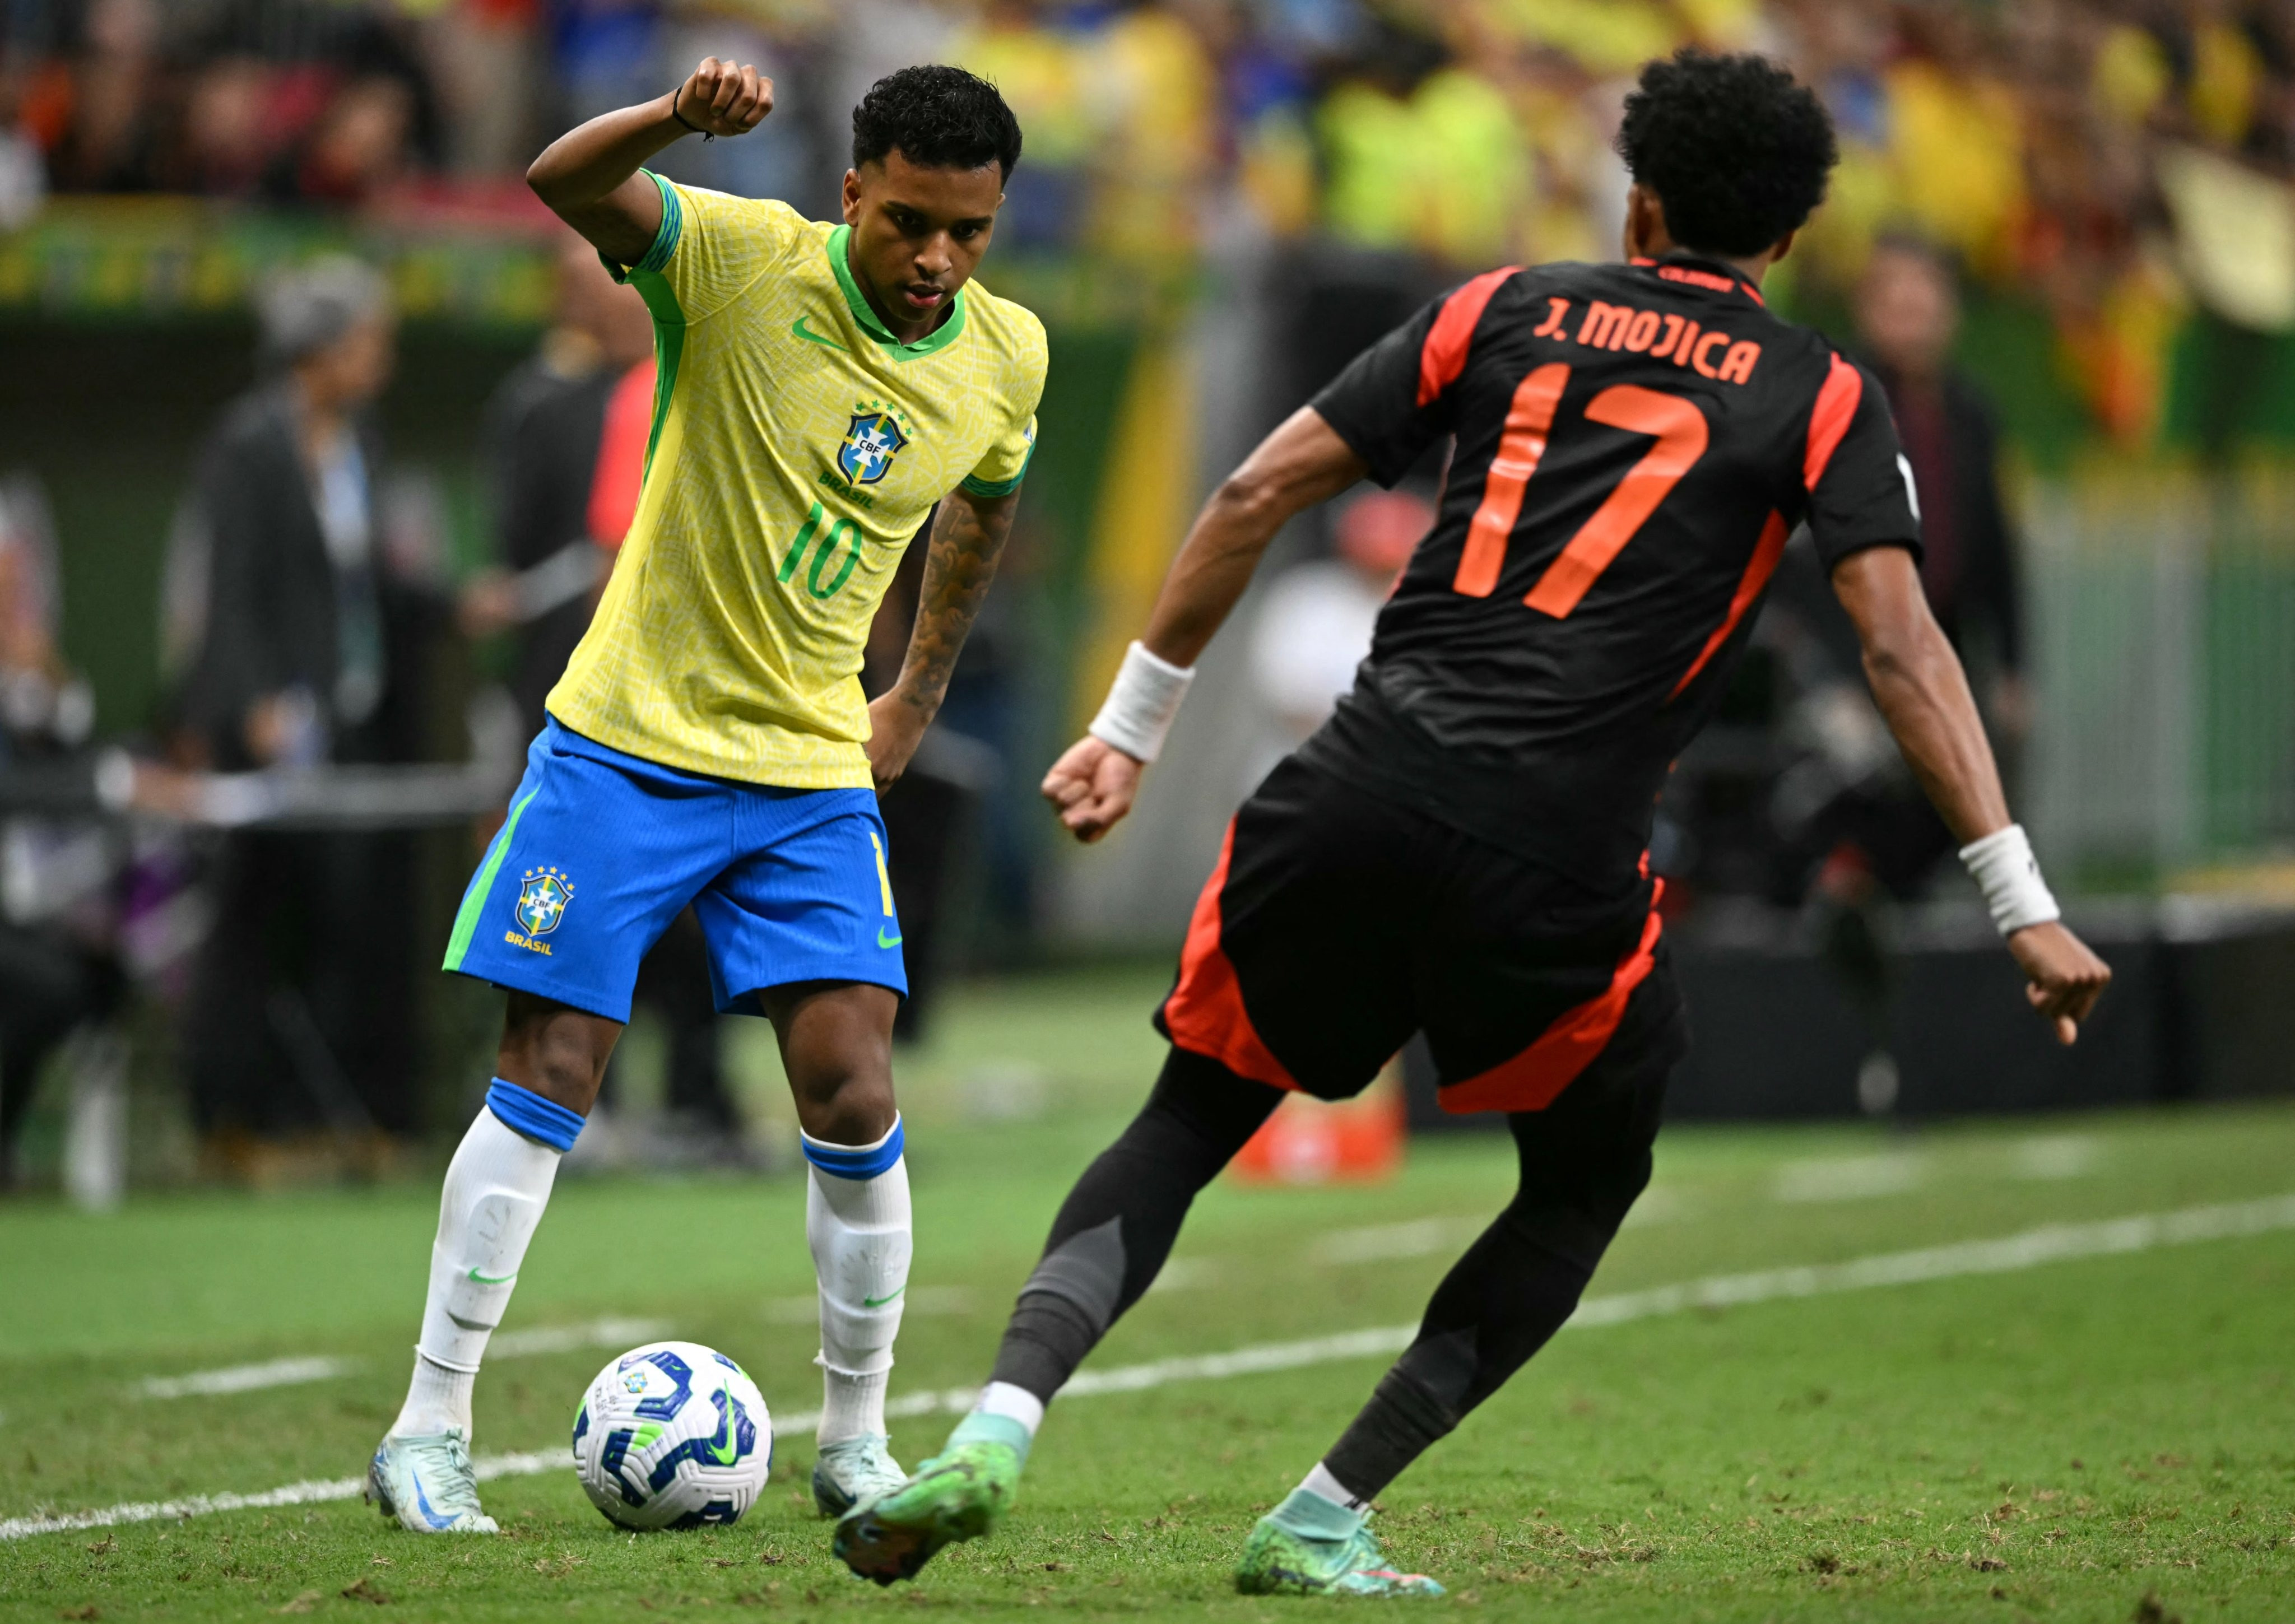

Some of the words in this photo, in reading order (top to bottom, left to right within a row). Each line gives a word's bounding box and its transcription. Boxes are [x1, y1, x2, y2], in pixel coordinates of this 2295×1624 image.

[1533, 297, 1571, 341] J.
[1576, 300, 1762, 385] MOJICA
[859, 439, 882, 455] CBF
[817, 471, 875, 509] BRASIL
[1452, 362, 1709, 620] 17
[776, 501, 863, 600] 10
[533, 898, 551, 909] CBF
[504, 930, 552, 956] BRASIL
